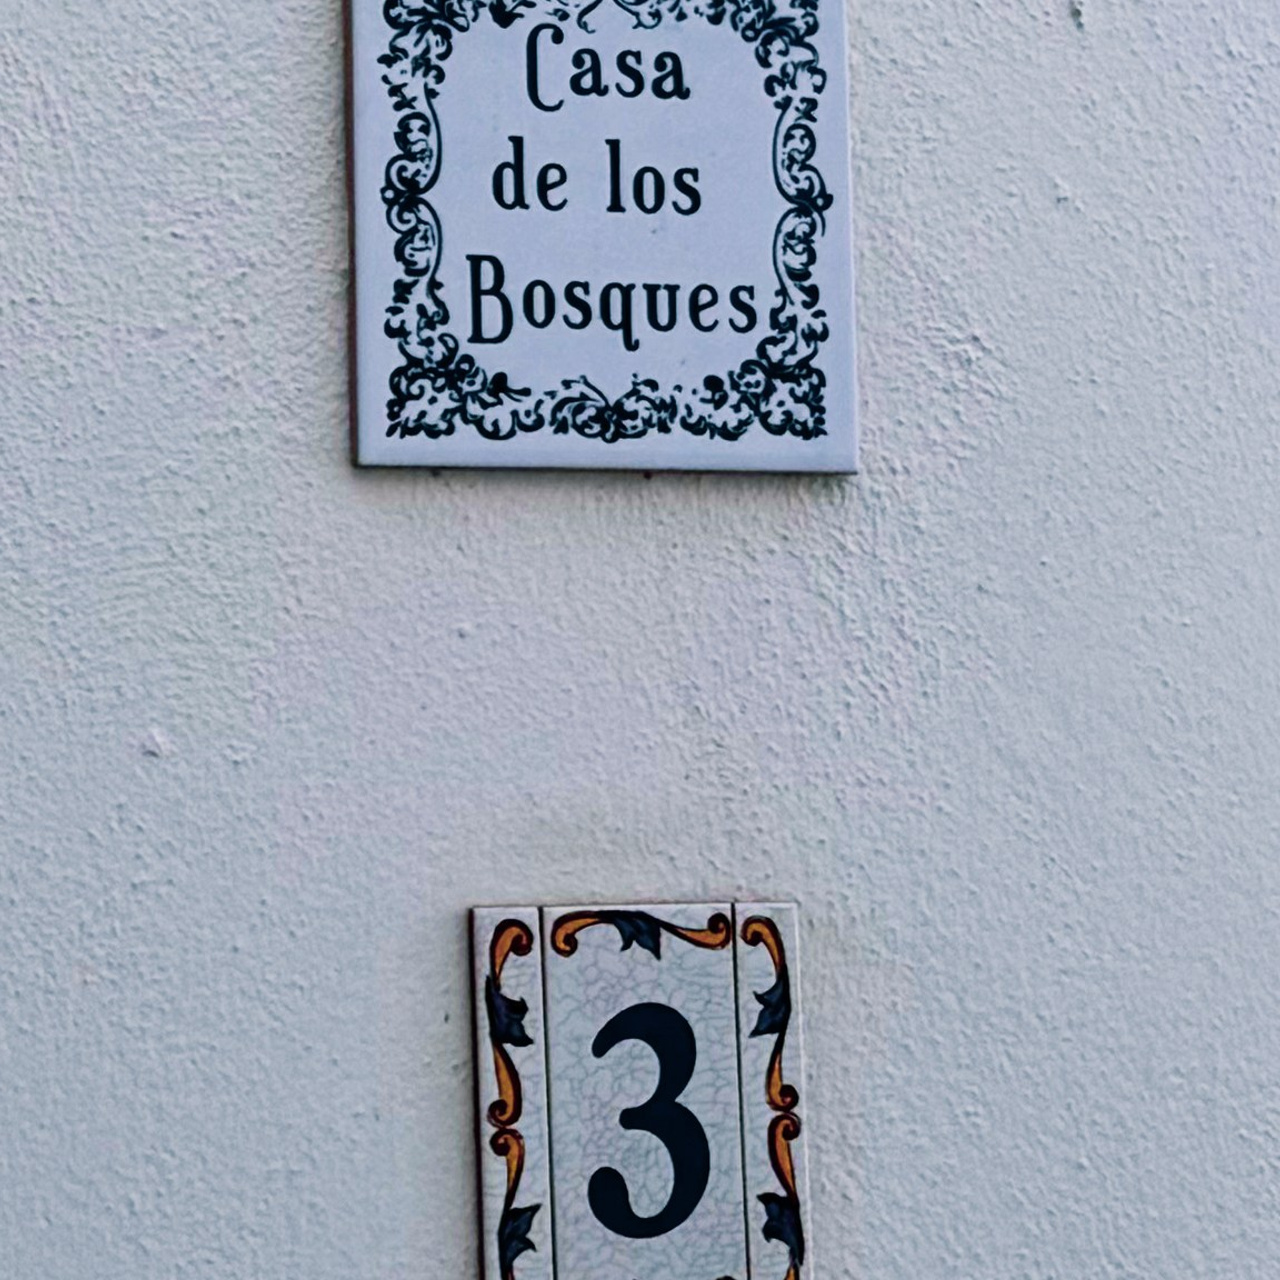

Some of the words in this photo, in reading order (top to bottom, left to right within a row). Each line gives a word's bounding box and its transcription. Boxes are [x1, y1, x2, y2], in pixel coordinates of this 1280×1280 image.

[525, 22, 692, 113] Casa
[492, 135, 569, 212] de
[604, 138, 702, 217] los
[465, 253, 758, 353] Bosques
[586, 1001, 712, 1240] 3
